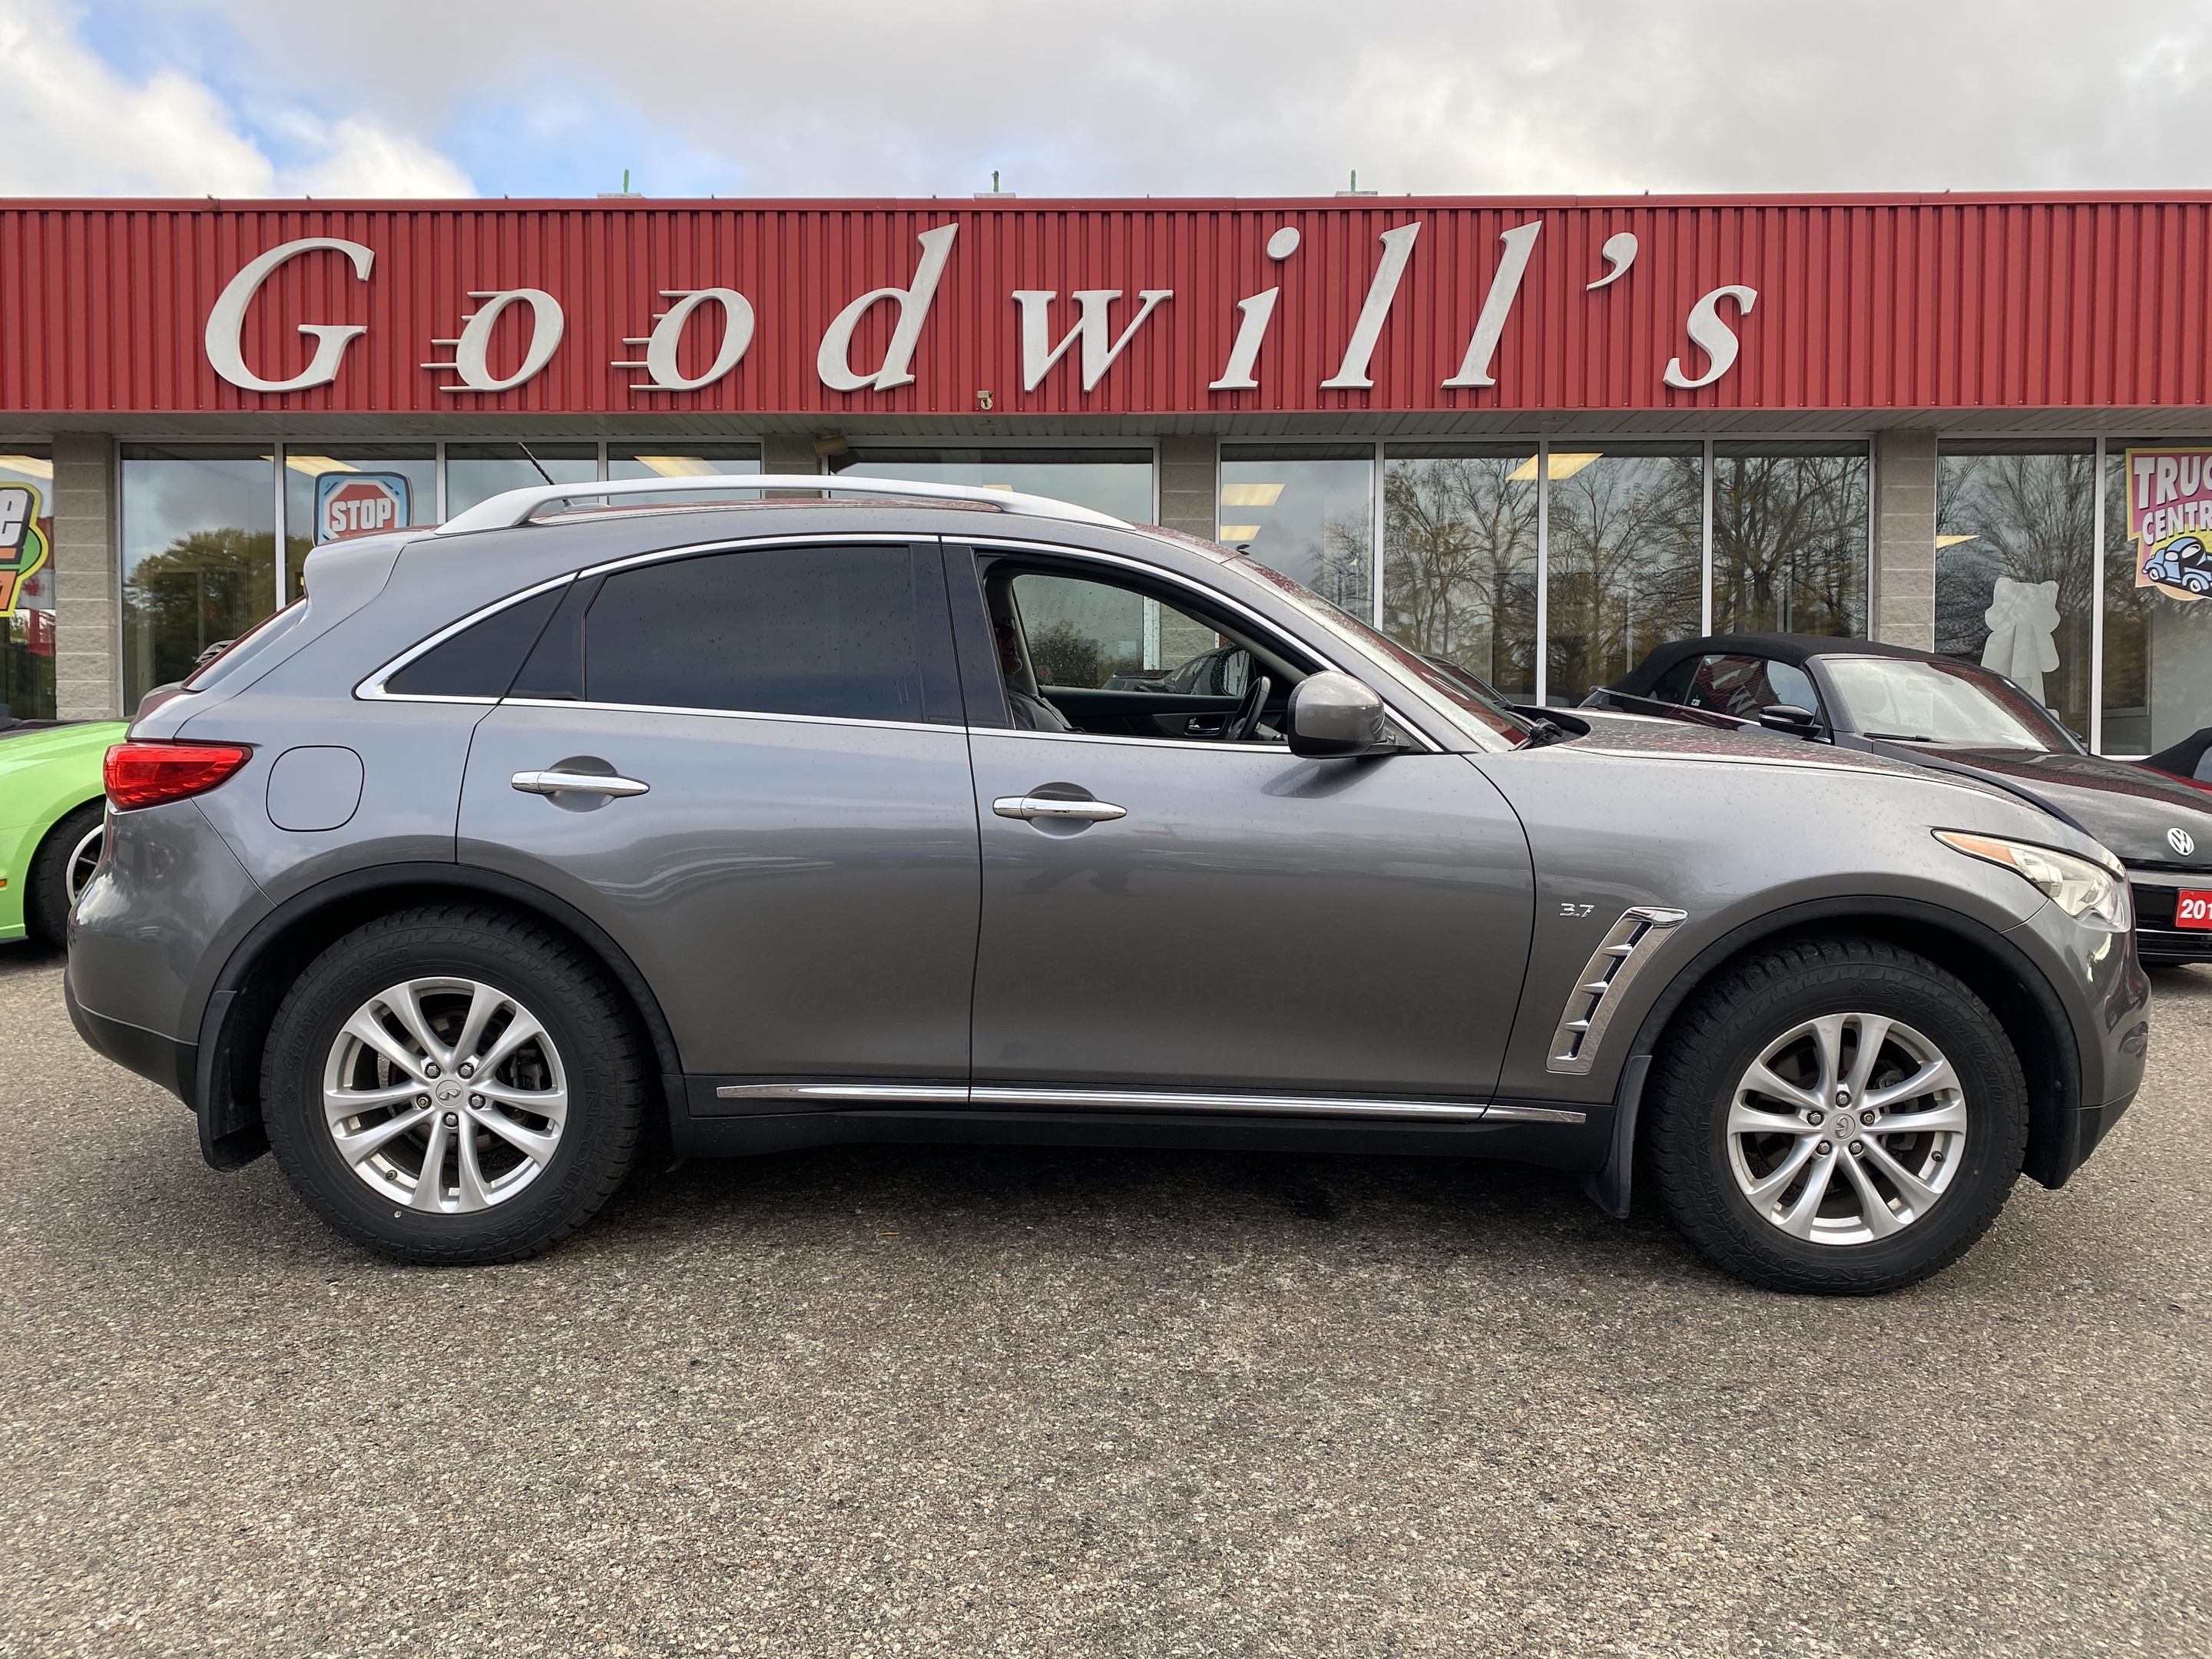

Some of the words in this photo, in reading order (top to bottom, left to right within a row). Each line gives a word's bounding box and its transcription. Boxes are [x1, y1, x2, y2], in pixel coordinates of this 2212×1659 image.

[204, 220, 1758, 393] Goodwill's
[331, 498, 392, 532] STOP
[1559, 902, 1595, 918] 3.7
[283, 949, 408, 1074] SUMITOMO
[1878, 984, 2004, 1103] SUMITOMO
[480, 1066, 600, 1245] ENCOUNTER
[1703, 1168, 1880, 1280] ENCOUNTER
